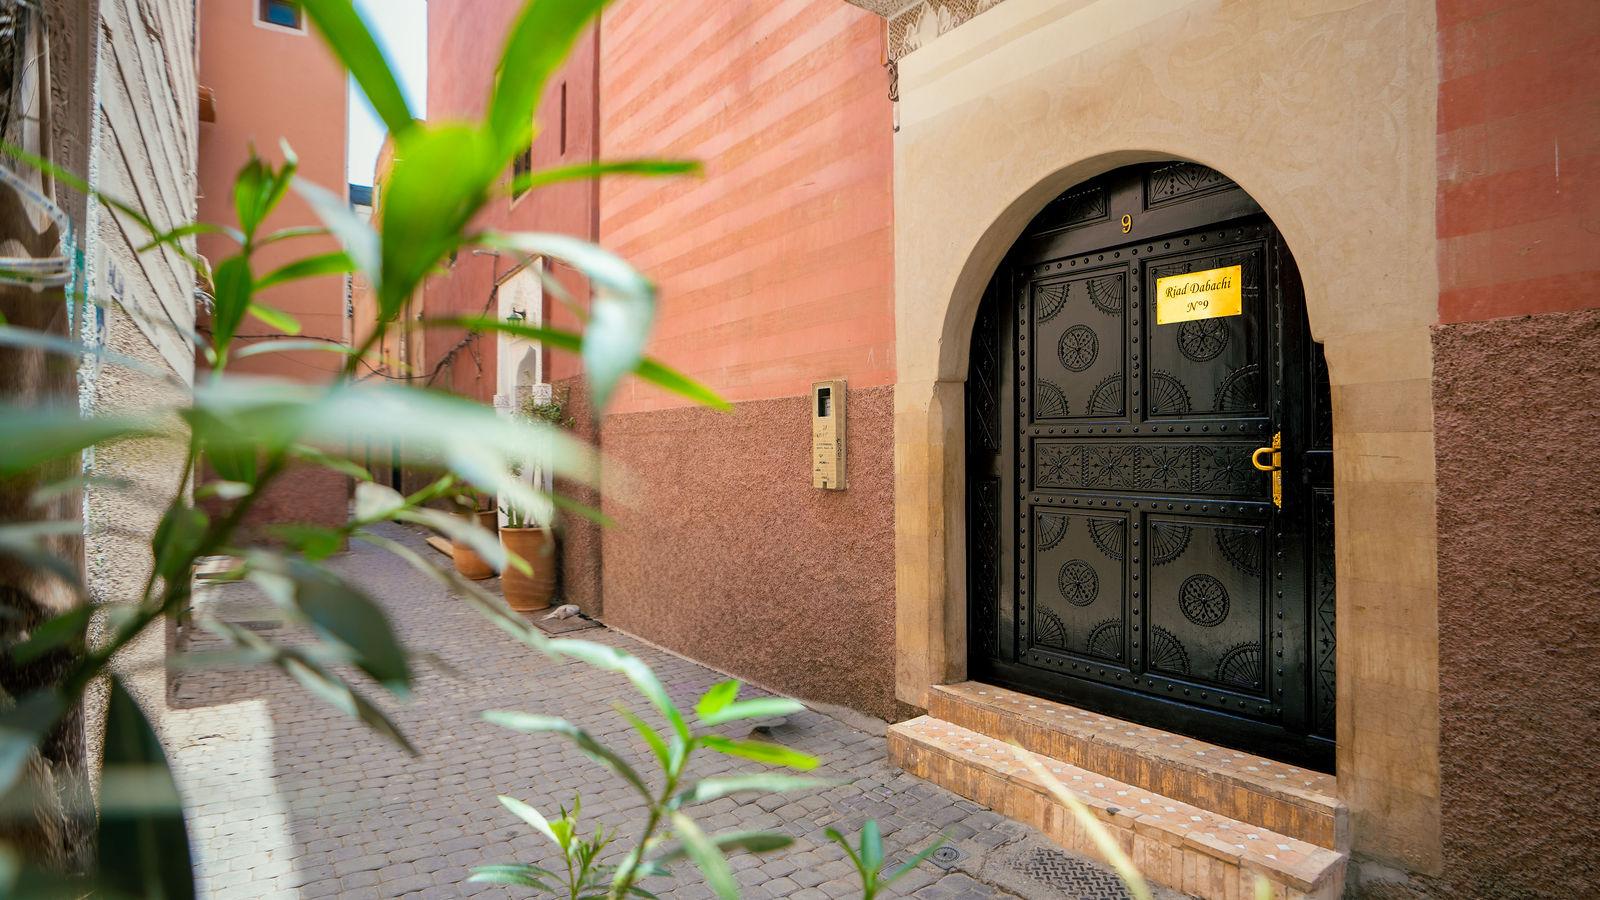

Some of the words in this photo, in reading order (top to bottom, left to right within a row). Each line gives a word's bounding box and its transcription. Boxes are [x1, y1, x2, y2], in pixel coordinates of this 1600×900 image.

[1121, 213, 1131, 233] 9
[1165, 283, 1189, 298] Riad
[1189, 277, 1231, 294] Dabachi
